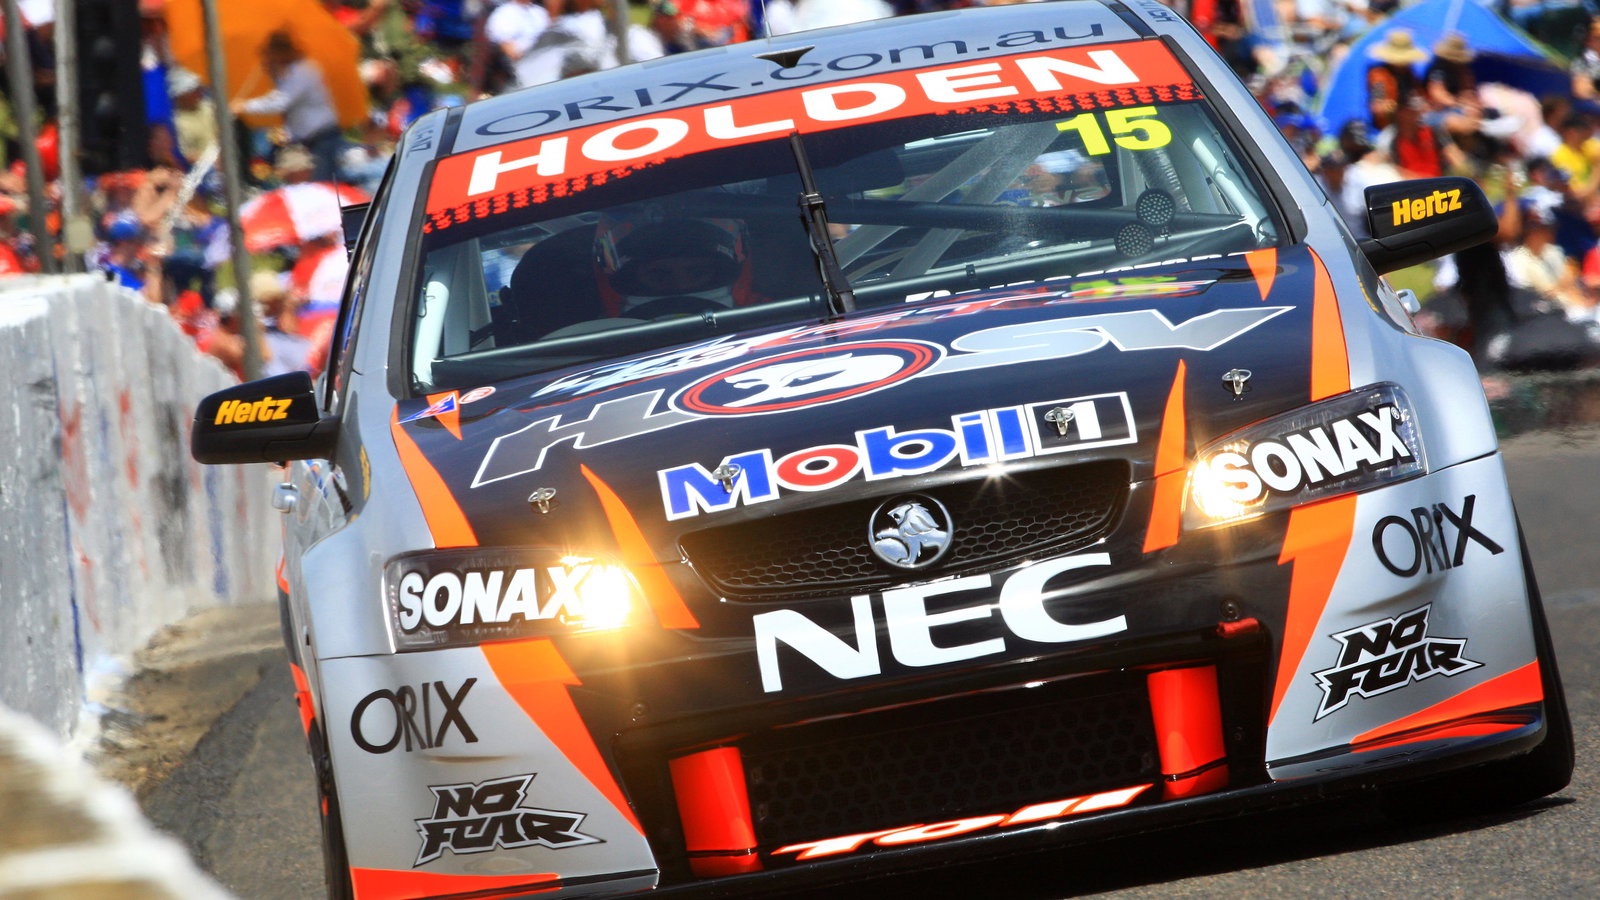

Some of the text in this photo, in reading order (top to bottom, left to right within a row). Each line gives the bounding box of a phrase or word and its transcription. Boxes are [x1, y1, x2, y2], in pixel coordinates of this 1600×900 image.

[474, 23, 1104, 136] ORIX.com.au
[467, 50, 1140, 196] HOLDEN
[1055, 105, 1172, 156] 15
[1392, 189, 1462, 226] Hertz
[213, 396, 293, 425] Hertz
[657, 404, 1036, 522] Mobil
[1202, 405, 1411, 503] SONAX
[1372, 494, 1505, 578] ORIX
[399, 565, 594, 632] SONAX
[752, 551, 1128, 693] NEC
[1332, 602, 1432, 668] NO
[350, 677, 479, 755] ORIX
[429, 774, 537, 821] NO
